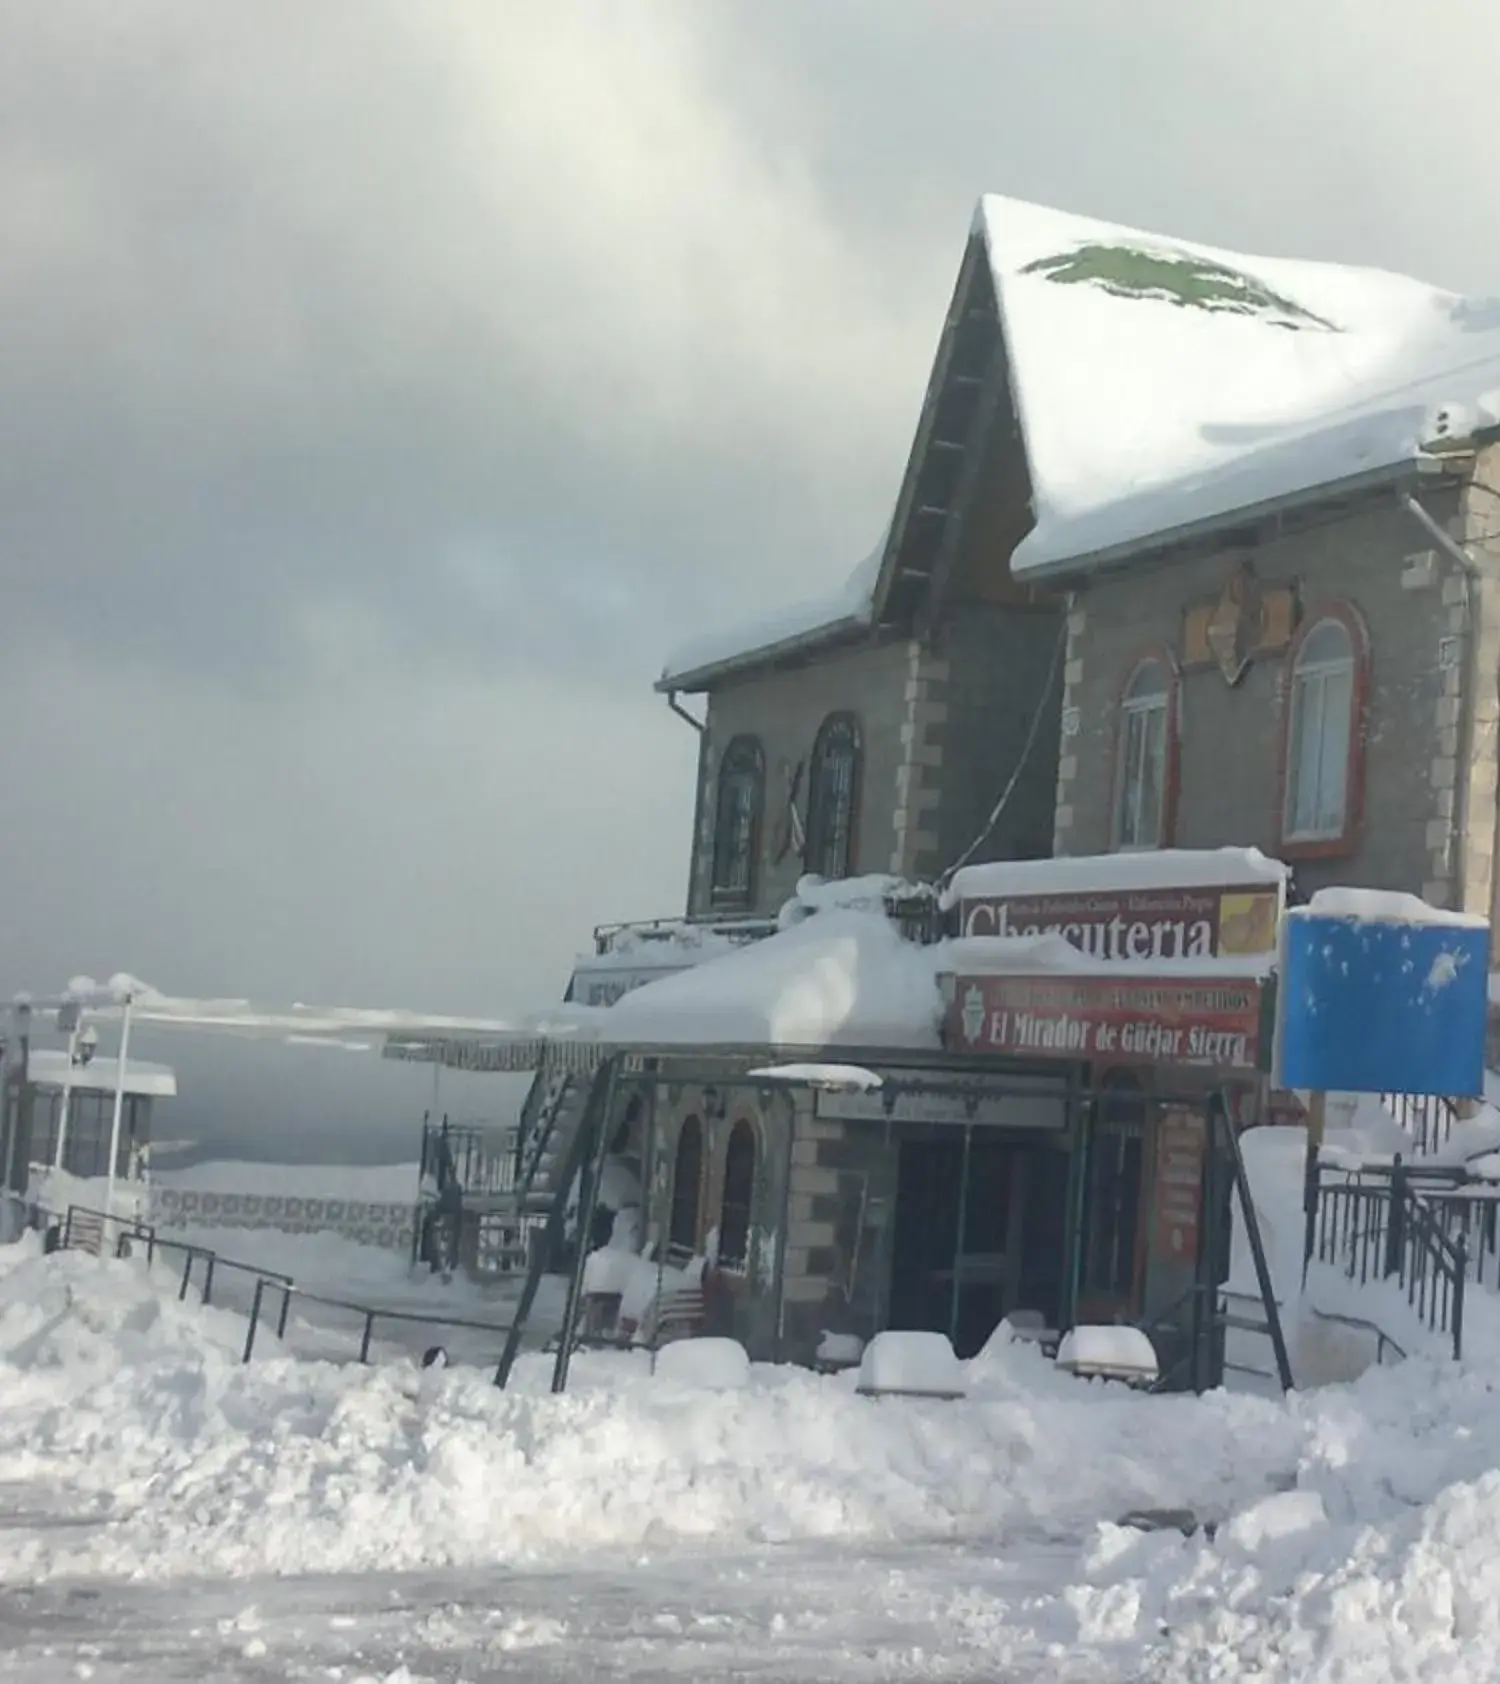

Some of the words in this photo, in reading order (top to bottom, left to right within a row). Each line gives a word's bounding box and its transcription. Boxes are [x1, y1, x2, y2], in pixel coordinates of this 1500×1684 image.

[989, 1012, 1008, 1045] El
[1013, 1012, 1091, 1049] Mirador
[1096, 1021, 1118, 1051] de
[1188, 1025, 1247, 1066] Sierra
